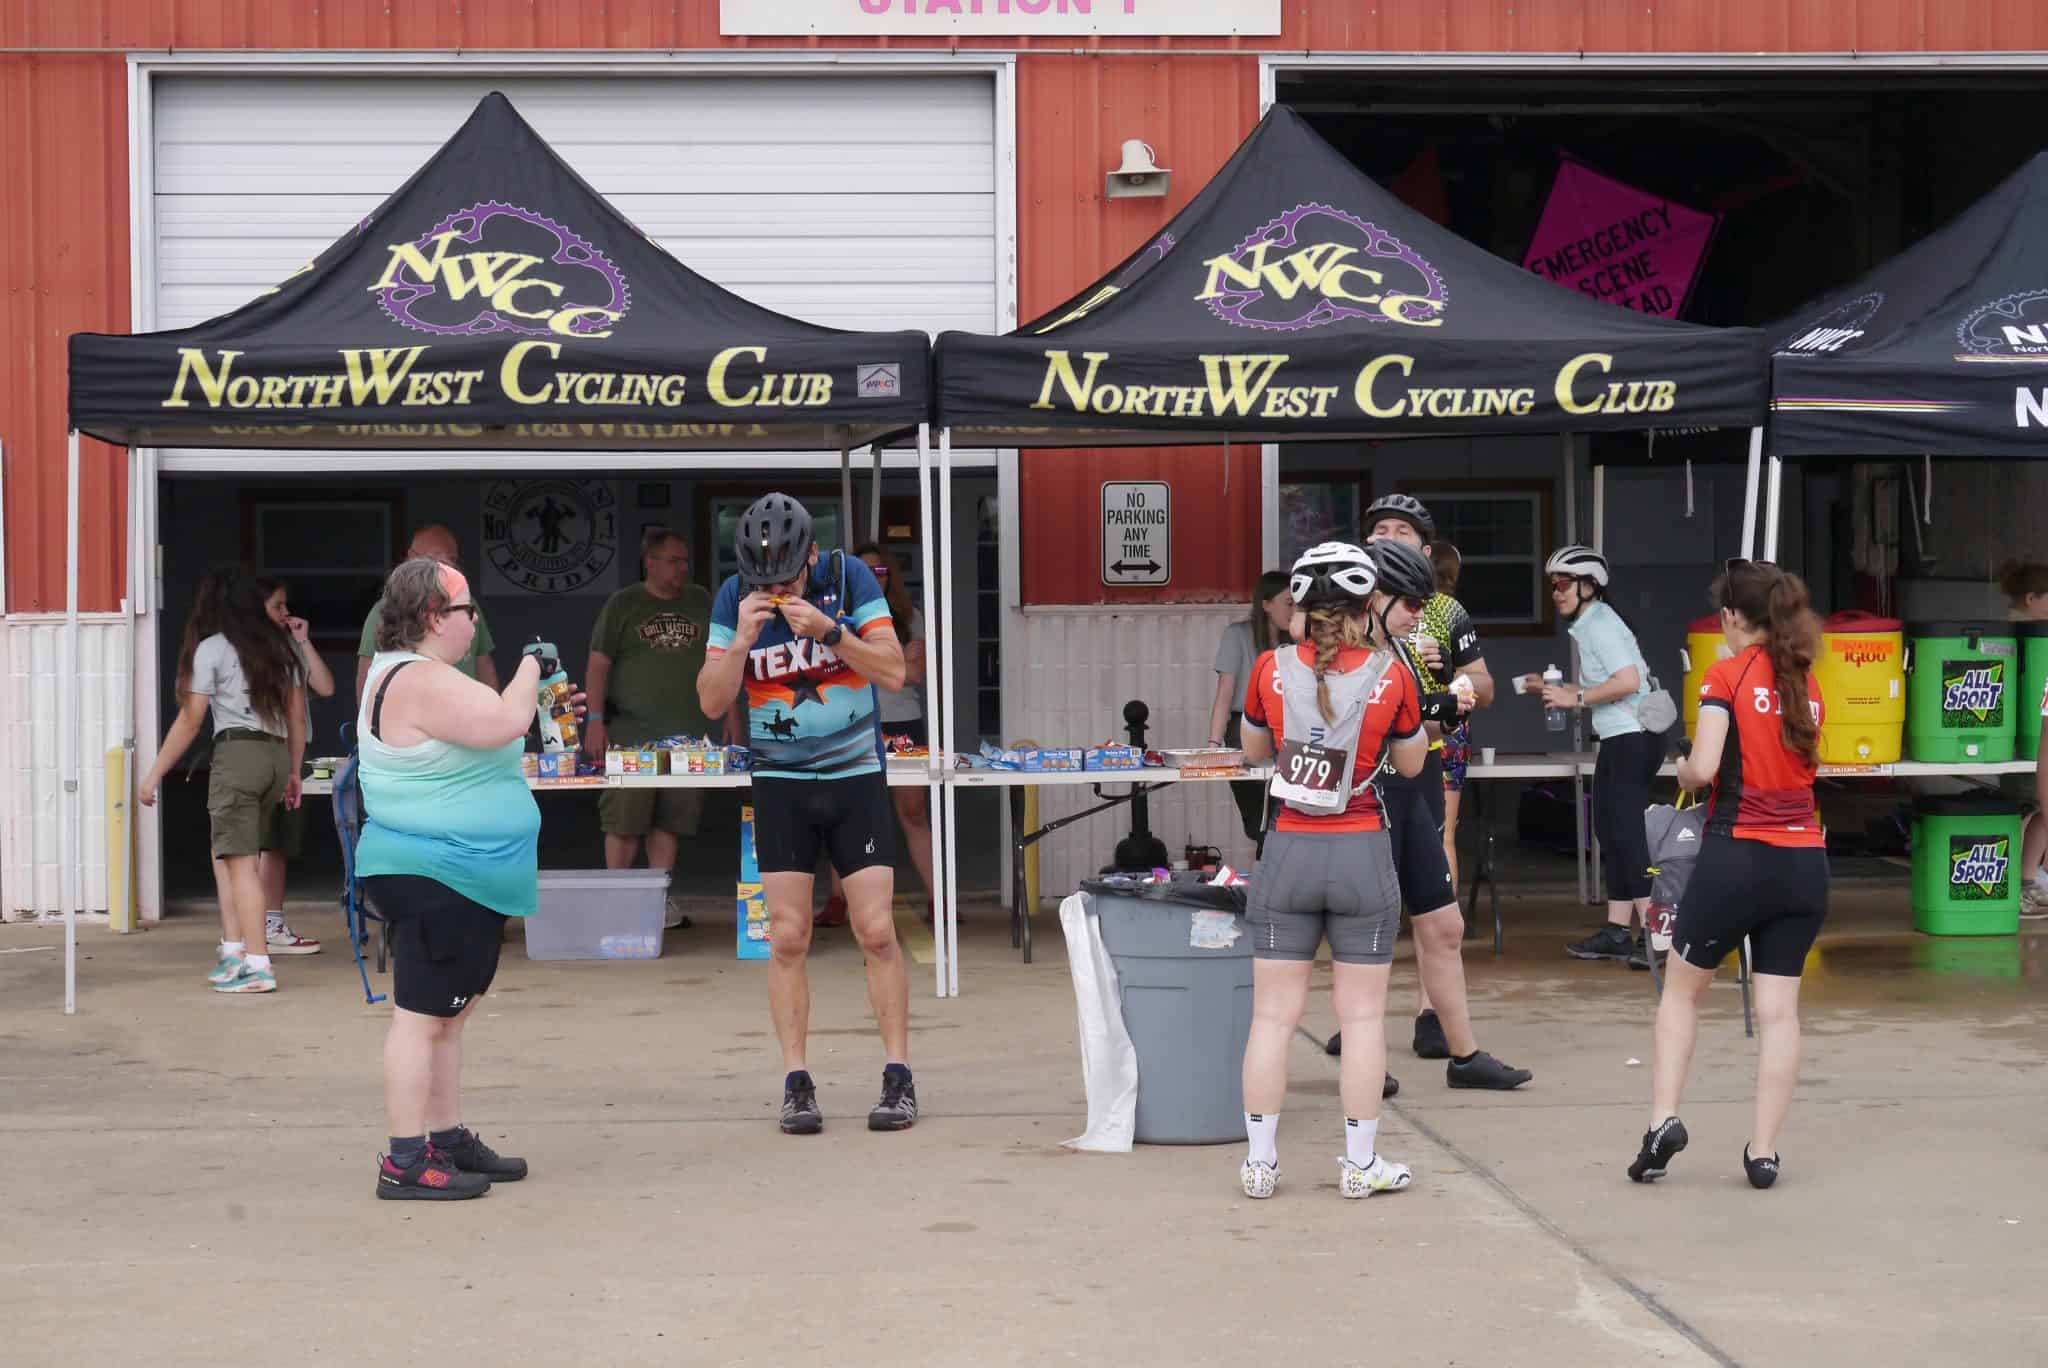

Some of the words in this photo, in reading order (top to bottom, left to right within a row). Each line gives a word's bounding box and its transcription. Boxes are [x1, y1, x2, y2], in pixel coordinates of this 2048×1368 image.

[367, 230, 620, 338] NWCC
[1194, 239, 1443, 326] NWCC
[161, 345, 485, 408] NORTHWEST
[500, 340, 686, 407] CYCLING
[706, 346, 833, 407] CLUB
[1030, 350, 1338, 417] NORTHWEST
[1354, 353, 1535, 418] CYCLING
[1554, 352, 1677, 414] CLUB
[1126, 492, 1145, 508] NO
[1107, 509, 1166, 525] PARKING
[1124, 528, 1148, 541] ANY
[1121, 544, 1152, 558] TIME
[502, 557, 603, 590] PRIDE
[749, 638, 837, 680] TEXA
[1961, 669, 1992, 689] ALL
[1944, 683, 2002, 709] SPORT
[1290, 755, 1331, 787] 979
[1969, 845, 1998, 863] ALL
[1952, 857, 2008, 882] SPORT
